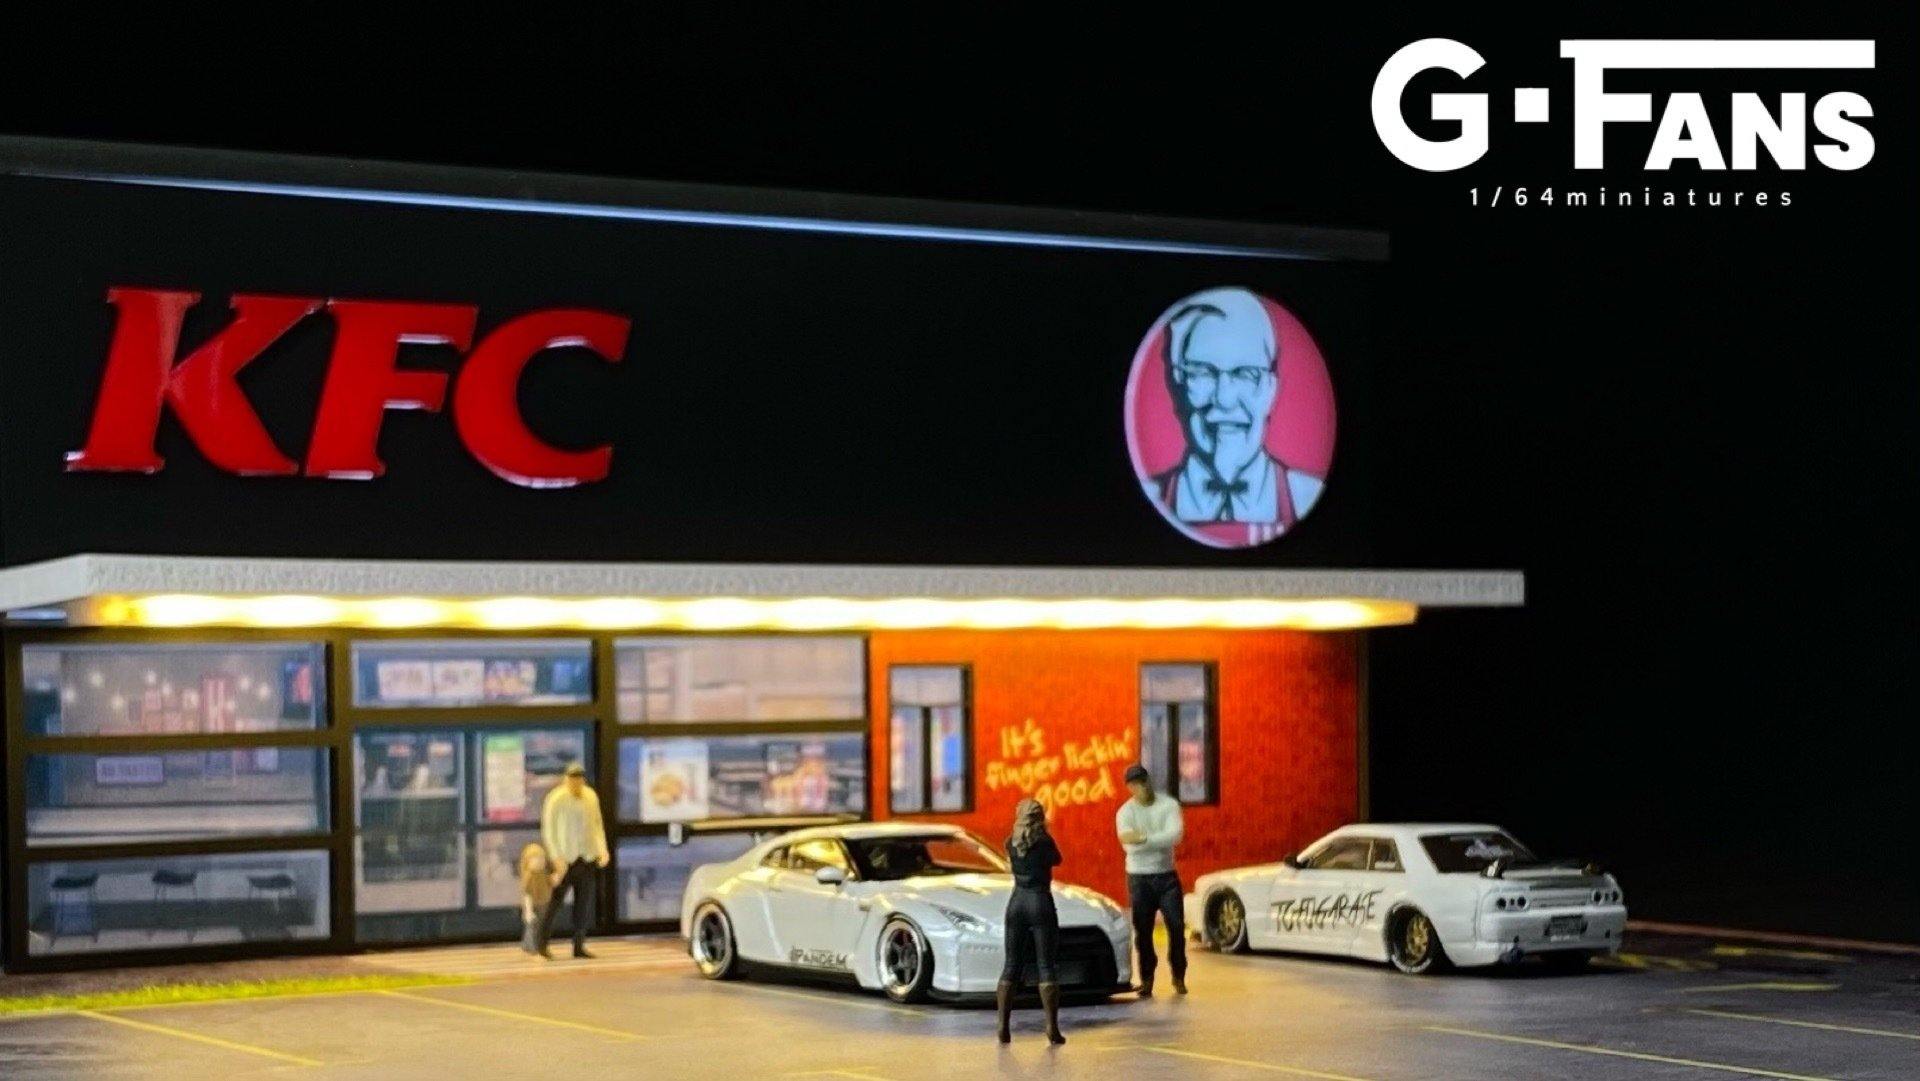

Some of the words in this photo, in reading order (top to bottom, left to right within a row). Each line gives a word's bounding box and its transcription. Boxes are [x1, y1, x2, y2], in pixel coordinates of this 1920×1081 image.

[64, 288, 631, 488] KFC
[1001, 718, 1046, 759] It's
[985, 755, 1061, 794] finger
[1034, 765, 1117, 823] good
